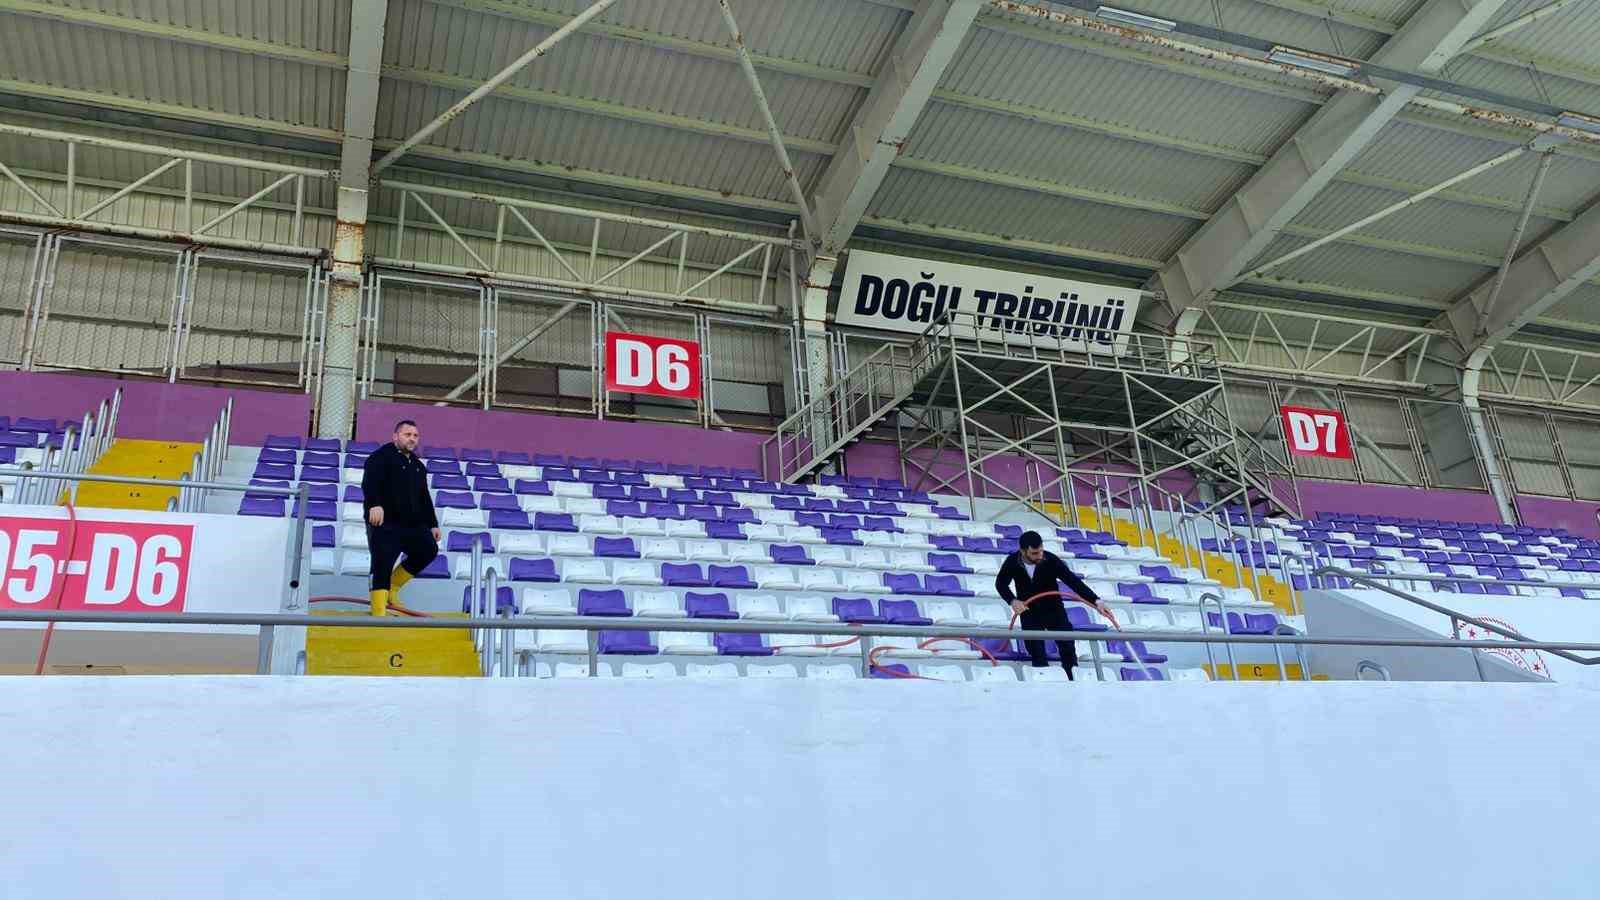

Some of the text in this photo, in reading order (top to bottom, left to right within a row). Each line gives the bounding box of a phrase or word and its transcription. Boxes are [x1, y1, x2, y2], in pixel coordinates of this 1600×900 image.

[854, 271, 1125, 345] DOĞU TRİBÜNÜ
[616, 338, 690, 391] D6
[1287, 411, 1338, 453] D7
[0, 528, 183, 607] 5-D6
